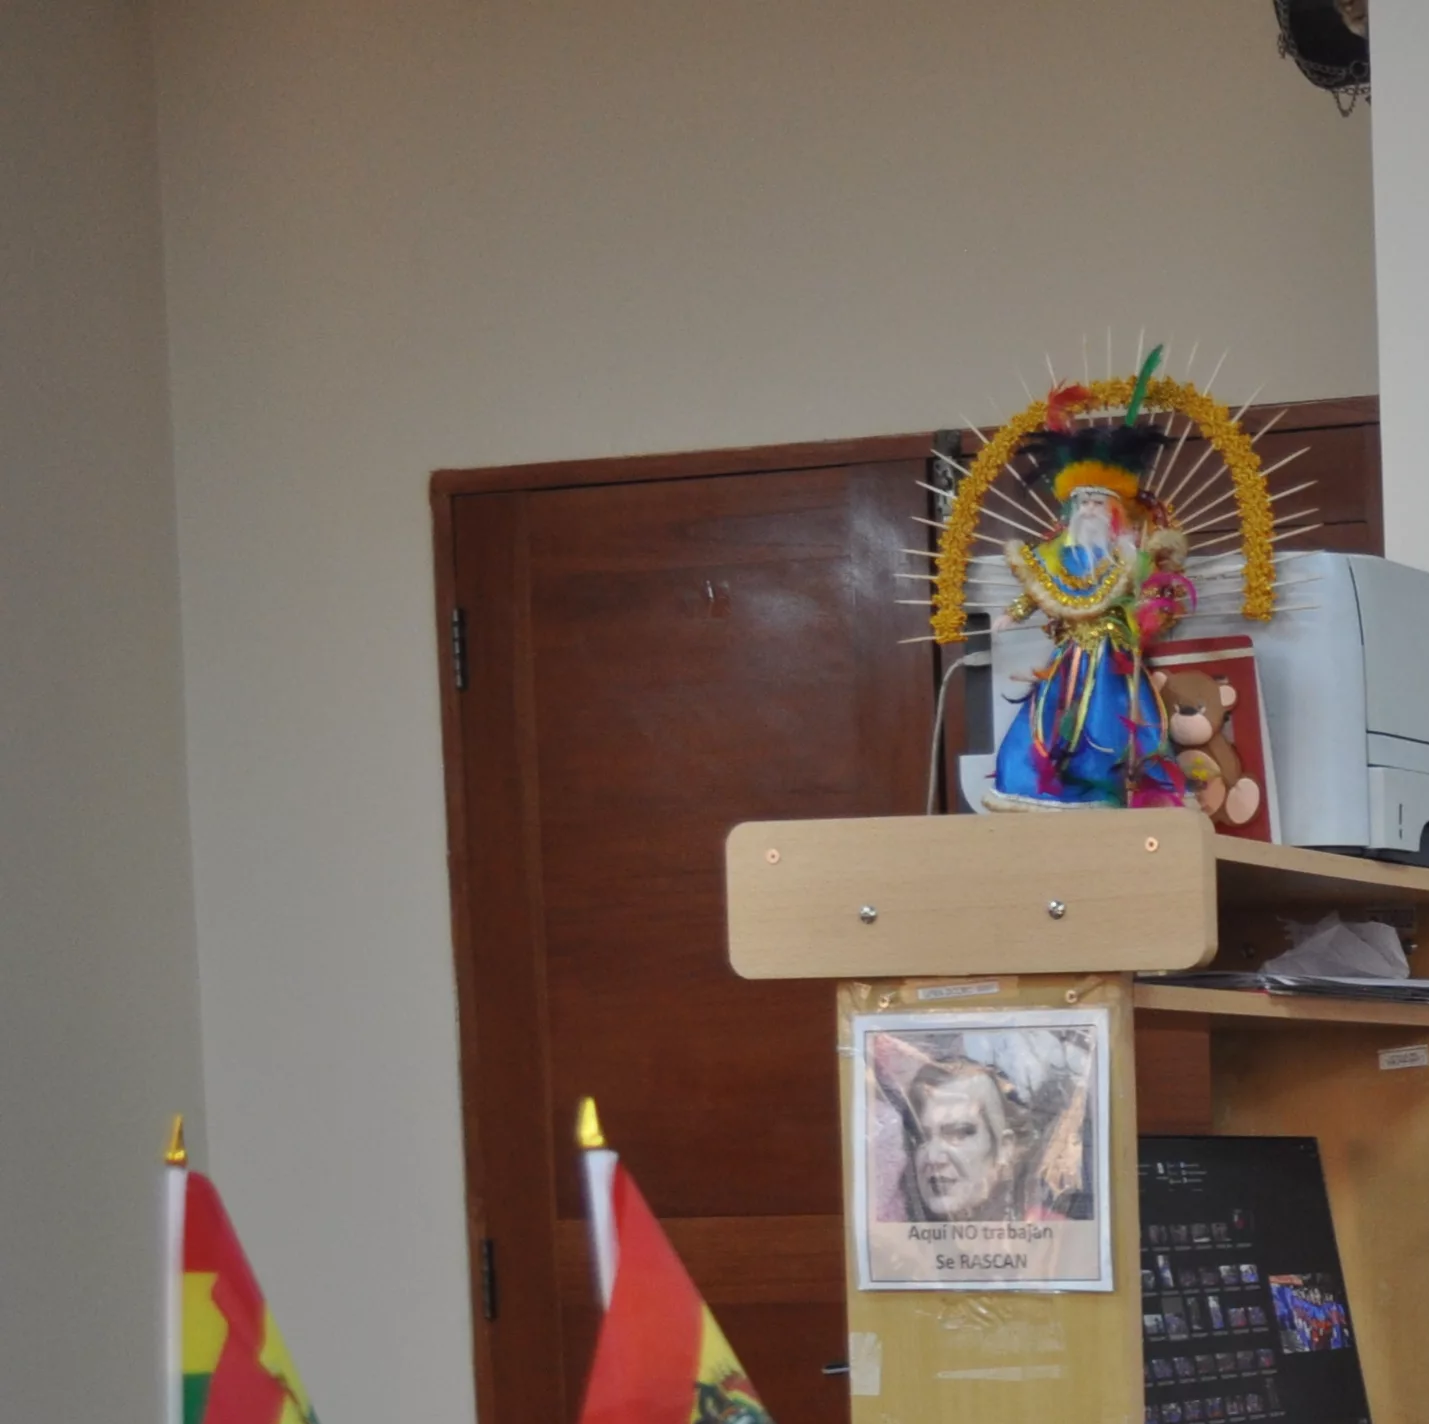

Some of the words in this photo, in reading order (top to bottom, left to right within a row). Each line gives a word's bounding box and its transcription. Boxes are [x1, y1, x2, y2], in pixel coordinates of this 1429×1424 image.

[952, 1225, 977, 1240] NO
[982, 1224, 1053, 1243] trabajan
[936, 1254, 955, 1269] Se
[960, 1253, 1027, 1268] RASCAN
